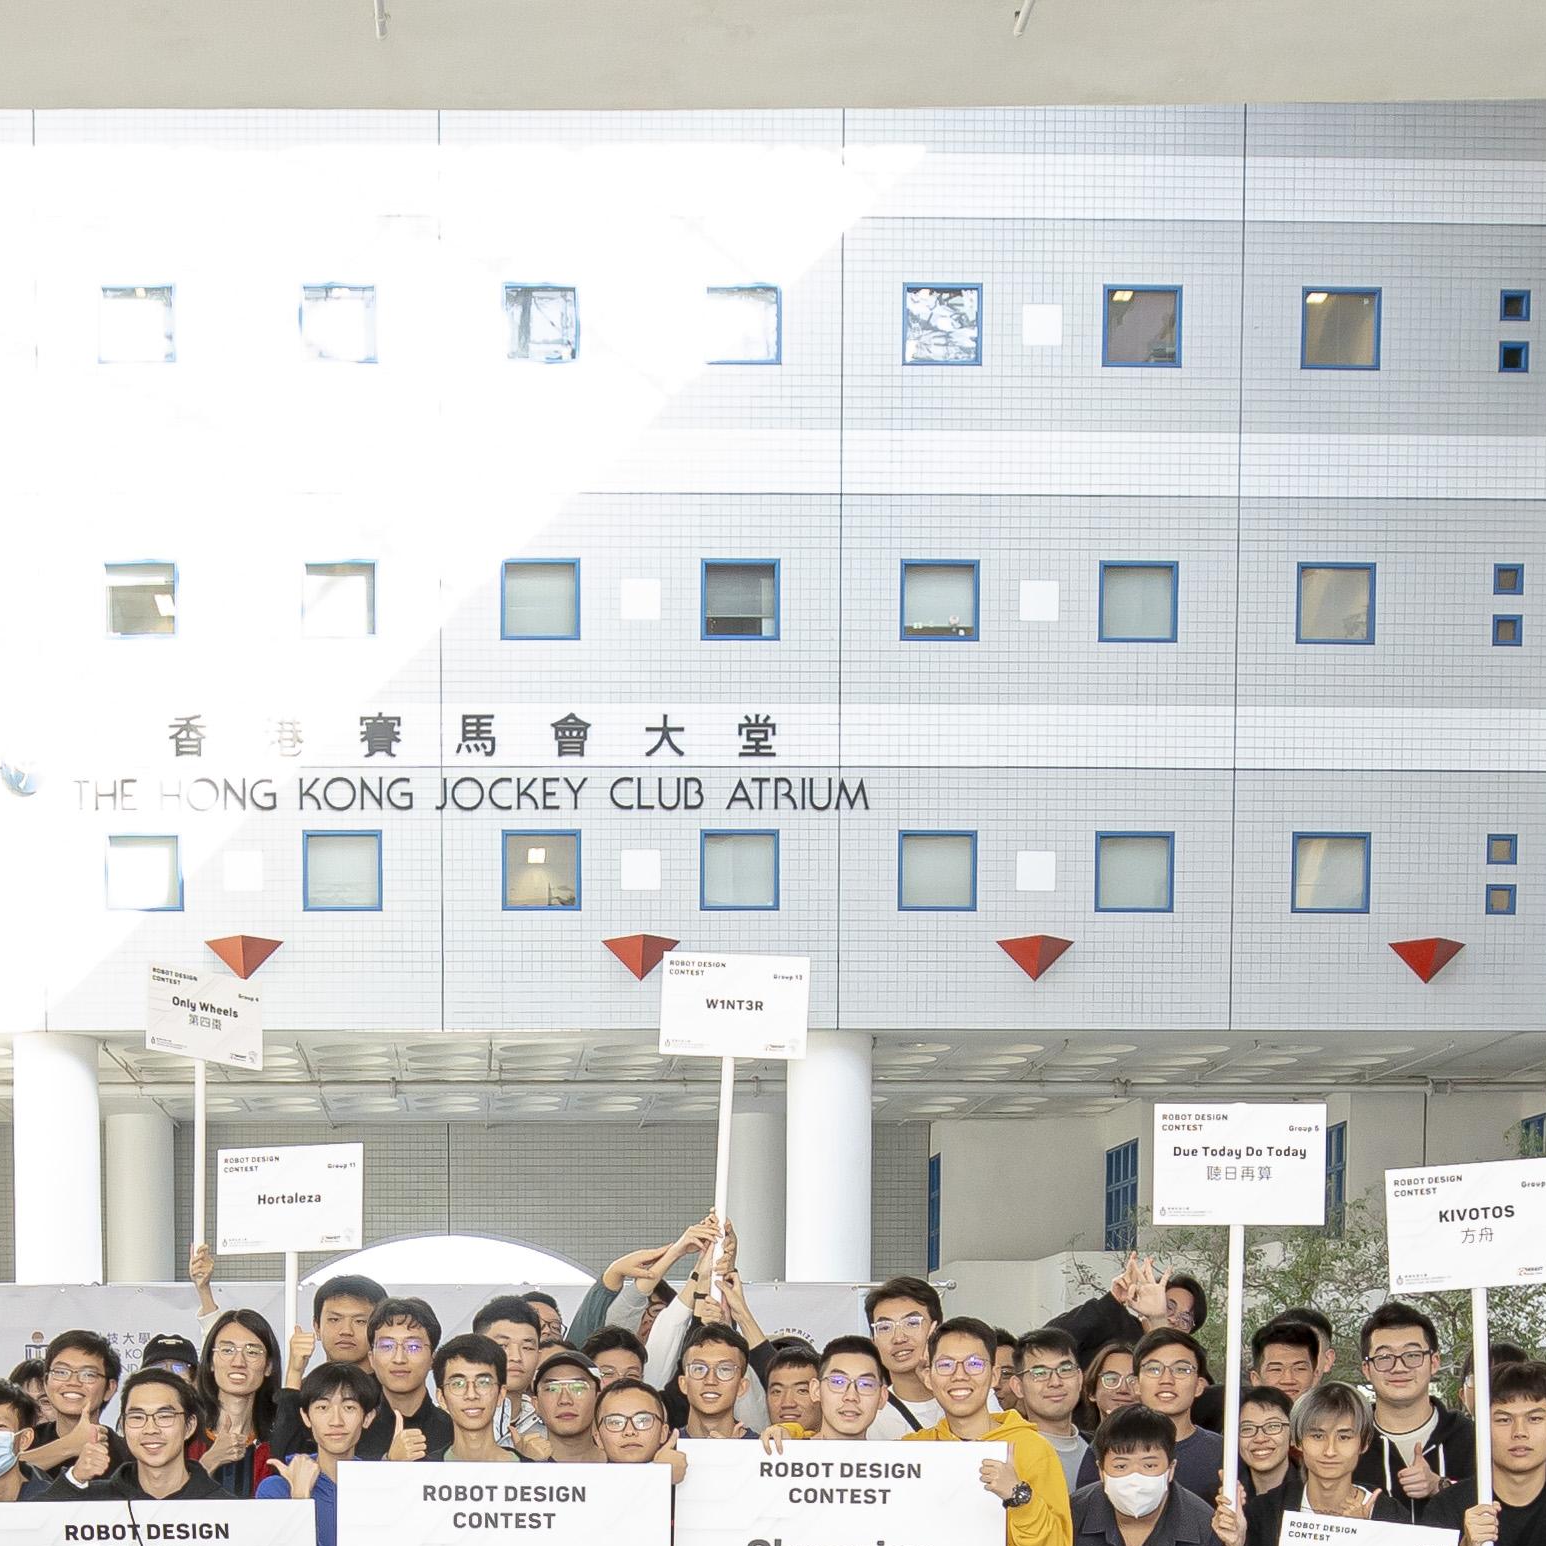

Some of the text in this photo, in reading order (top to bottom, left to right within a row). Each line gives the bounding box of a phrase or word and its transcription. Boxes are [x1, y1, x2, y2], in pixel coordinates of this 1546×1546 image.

[167, 711, 778, 759] 香港賽馬會大堂
[73, 776, 870, 813] THE HONG KONG JOCKEY CLUB ATRIUM
[172, 996, 238, 1018] Only Wheels
[706, 998, 764, 1011] W1NT3R
[1173, 1146, 1307, 1159] Due Today Do Today
[1207, 1166, 1273, 1181] 聽日再算
[1394, 1175, 1462, 1187] ROBOT DESIGN
[1521, 1180, 1546, 1188] Group
[257, 1192, 321, 1205] Hortaleza
[1394, 1187, 1437, 1198] CONTEST
[1439, 1205, 1515, 1223] KIVOTOS
[1461, 1227, 1494, 1244] 方舟
[760, 1462, 920, 1478] ROBOT DESIGN
[424, 1485, 585, 1502] ROBOT DESIGN
[789, 1488, 891, 1504] CONTEST
[454, 1512, 556, 1529] CONTEST
[1290, 1520, 1358, 1535] ROBOT DESIGN
[64, 1522, 230, 1542] ROBOT DESIGN
[1288, 1531, 1331, 1542] CONTEST
